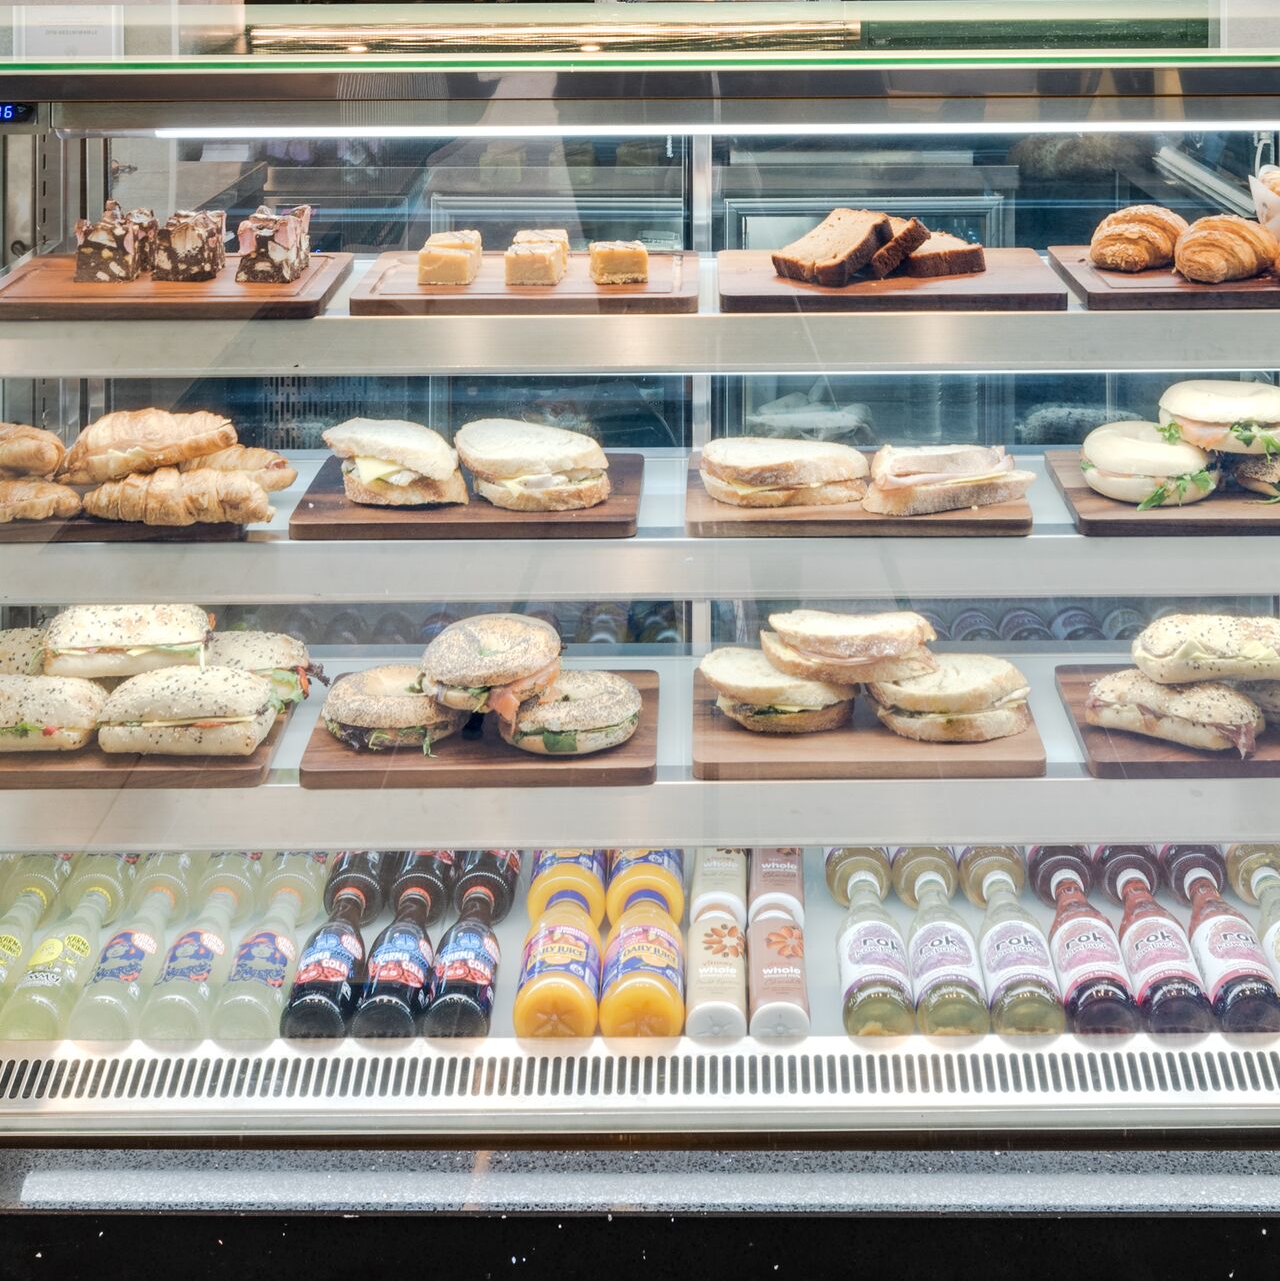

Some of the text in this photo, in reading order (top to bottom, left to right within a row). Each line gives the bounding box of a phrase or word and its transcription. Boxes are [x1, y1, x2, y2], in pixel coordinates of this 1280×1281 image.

[703, 861, 738, 870] whole
[761, 861, 798, 870] whole
[919, 935, 957, 955] rok
[994, 935, 1034, 952] rok
[1065, 932, 1103, 950] rok
[1134, 931, 1173, 952] rok
[556, 945, 585, 959] JUICE
[622, 943, 651, 959] DAILY
[323, 958, 348, 973] COLA
[402, 960, 425, 977] COLA
[468, 958, 490, 975] COLA
[698, 966, 737, 975] whole
[762, 966, 801, 976] whole
